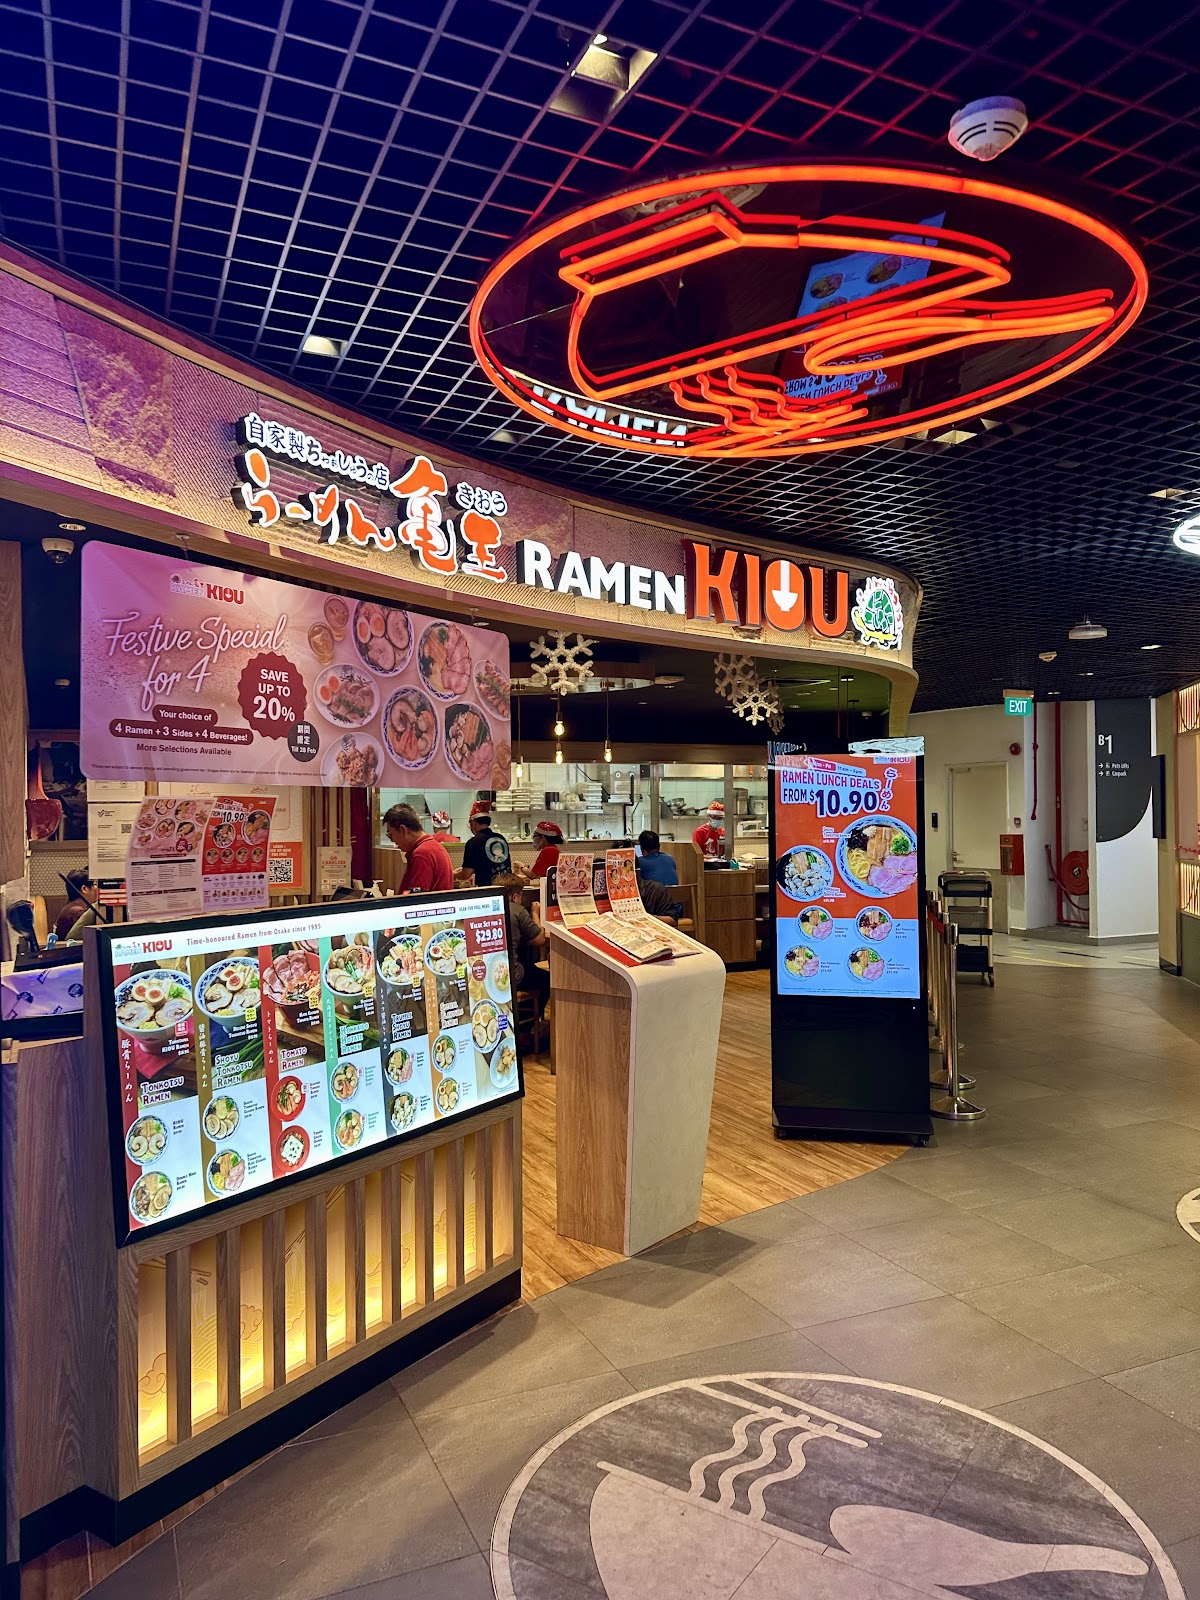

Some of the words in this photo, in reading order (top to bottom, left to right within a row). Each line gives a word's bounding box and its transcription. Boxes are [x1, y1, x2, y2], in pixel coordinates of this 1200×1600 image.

[456, 482, 508, 515] きおう
[206, 583, 244, 605] KIOU
[523, 540, 686, 614] RAMEN
[691, 543, 849, 638] KIOU
[103, 611, 193, 656] Festive
[197, 614, 288, 663] Special
[260, 668, 289, 683] SAVE
[142, 656, 180, 712] for
[187, 655, 211, 693] 4
[258, 683, 274, 695] UP
[276, 685, 291, 697] TO
[253, 696, 295, 722] 20%
[1009, 700, 1027, 713] EXIT
[159, 710, 176, 719] Your
[178, 711, 202, 721] choice
[204, 713, 212, 721] of
[115, 723, 122, 732] 4
[125, 725, 153, 735] Ramen
[162, 726, 170, 736] 3
[171, 728, 193, 738] Sides
[194, 730, 200, 738] +
[201, 729, 208, 739] 4
[209, 731, 248, 742] Beverages!
[136, 743, 157, 752] More
[159, 744, 198, 754] Selections
[199, 746, 232, 756] Available
[1098, 734, 1113, 754] B1
[782, 770, 814, 785] RAMEN
[817, 773, 847, 788] LUNCH
[850, 778, 880, 790] DEALS
[881, 768, 897, 811] らーめん
[783, 788, 807, 802] FROM
[810, 790, 877, 816] $10.90
[470, 921, 483, 929] VALUE
[483, 920, 491, 928] SET
[187, 933, 236, 946] Time-honoured
[237, 931, 258, 940] Ramen
[258, 929, 273, 937] from
[273, 926, 291, 936] Osaka
[307, 923, 322, 931] 1995
[476, 928, 503, 944] $29.80
[114, 947, 142, 957] RAMEN
[142, 939, 172, 953] KIOU
[391, 1011, 413, 1022] TRUFFLE
[441, 1018, 459, 1029] RAMEN
[340, 1022, 370, 1035] HOKKAIDO
[392, 1020, 411, 1031] SHOYU
[340, 1033, 364, 1044] HOTATE
[393, 1029, 412, 1040] RAMEN
[281, 1047, 308, 1059] TOMATO
[341, 1043, 362, 1055] RAMEN
[215, 1053, 240, 1065] SHOYU
[281, 1059, 305, 1071] RAMEN
[121, 1038, 134, 1103] 豚骨らーめん
[216, 1061, 253, 1076] TONKOTSU
[141, 1076, 184, 1094] TONKOTSU
[217, 1075, 242, 1088] RAMEN
[142, 1091, 171, 1106] RAMEN
